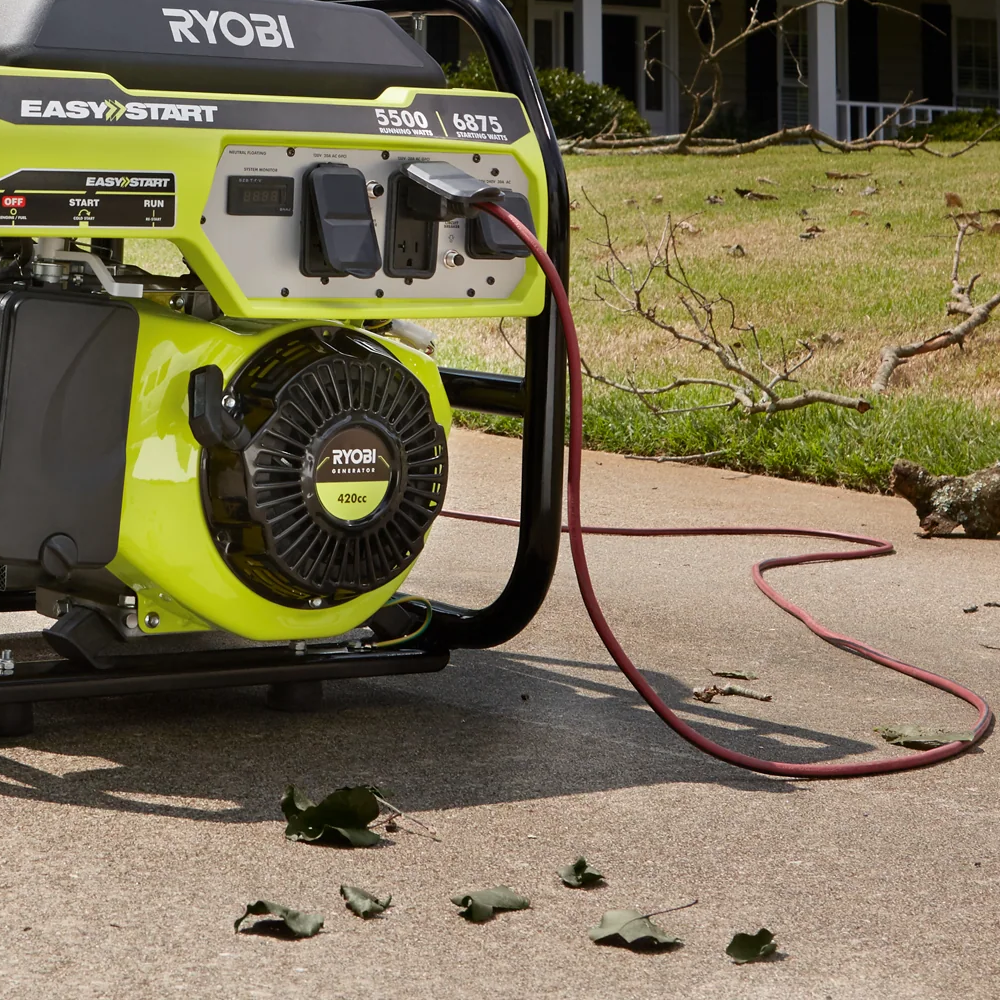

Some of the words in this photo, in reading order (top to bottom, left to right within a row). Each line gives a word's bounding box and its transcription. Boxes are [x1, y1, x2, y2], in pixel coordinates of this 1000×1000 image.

[161, 7, 295, 49] RYOBI
[375, 109, 428, 129] 5500
[453, 113, 503, 133] 6875
[379, 127, 411, 135] RUNNING
[456, 131, 487, 139] STARTING
[4, 198, 23, 206] OFF
[69, 199, 100, 207] START
[144, 200, 165, 208] RUN
[332, 449, 376, 464] RYOBI
[337, 493, 367, 504] 420cc
